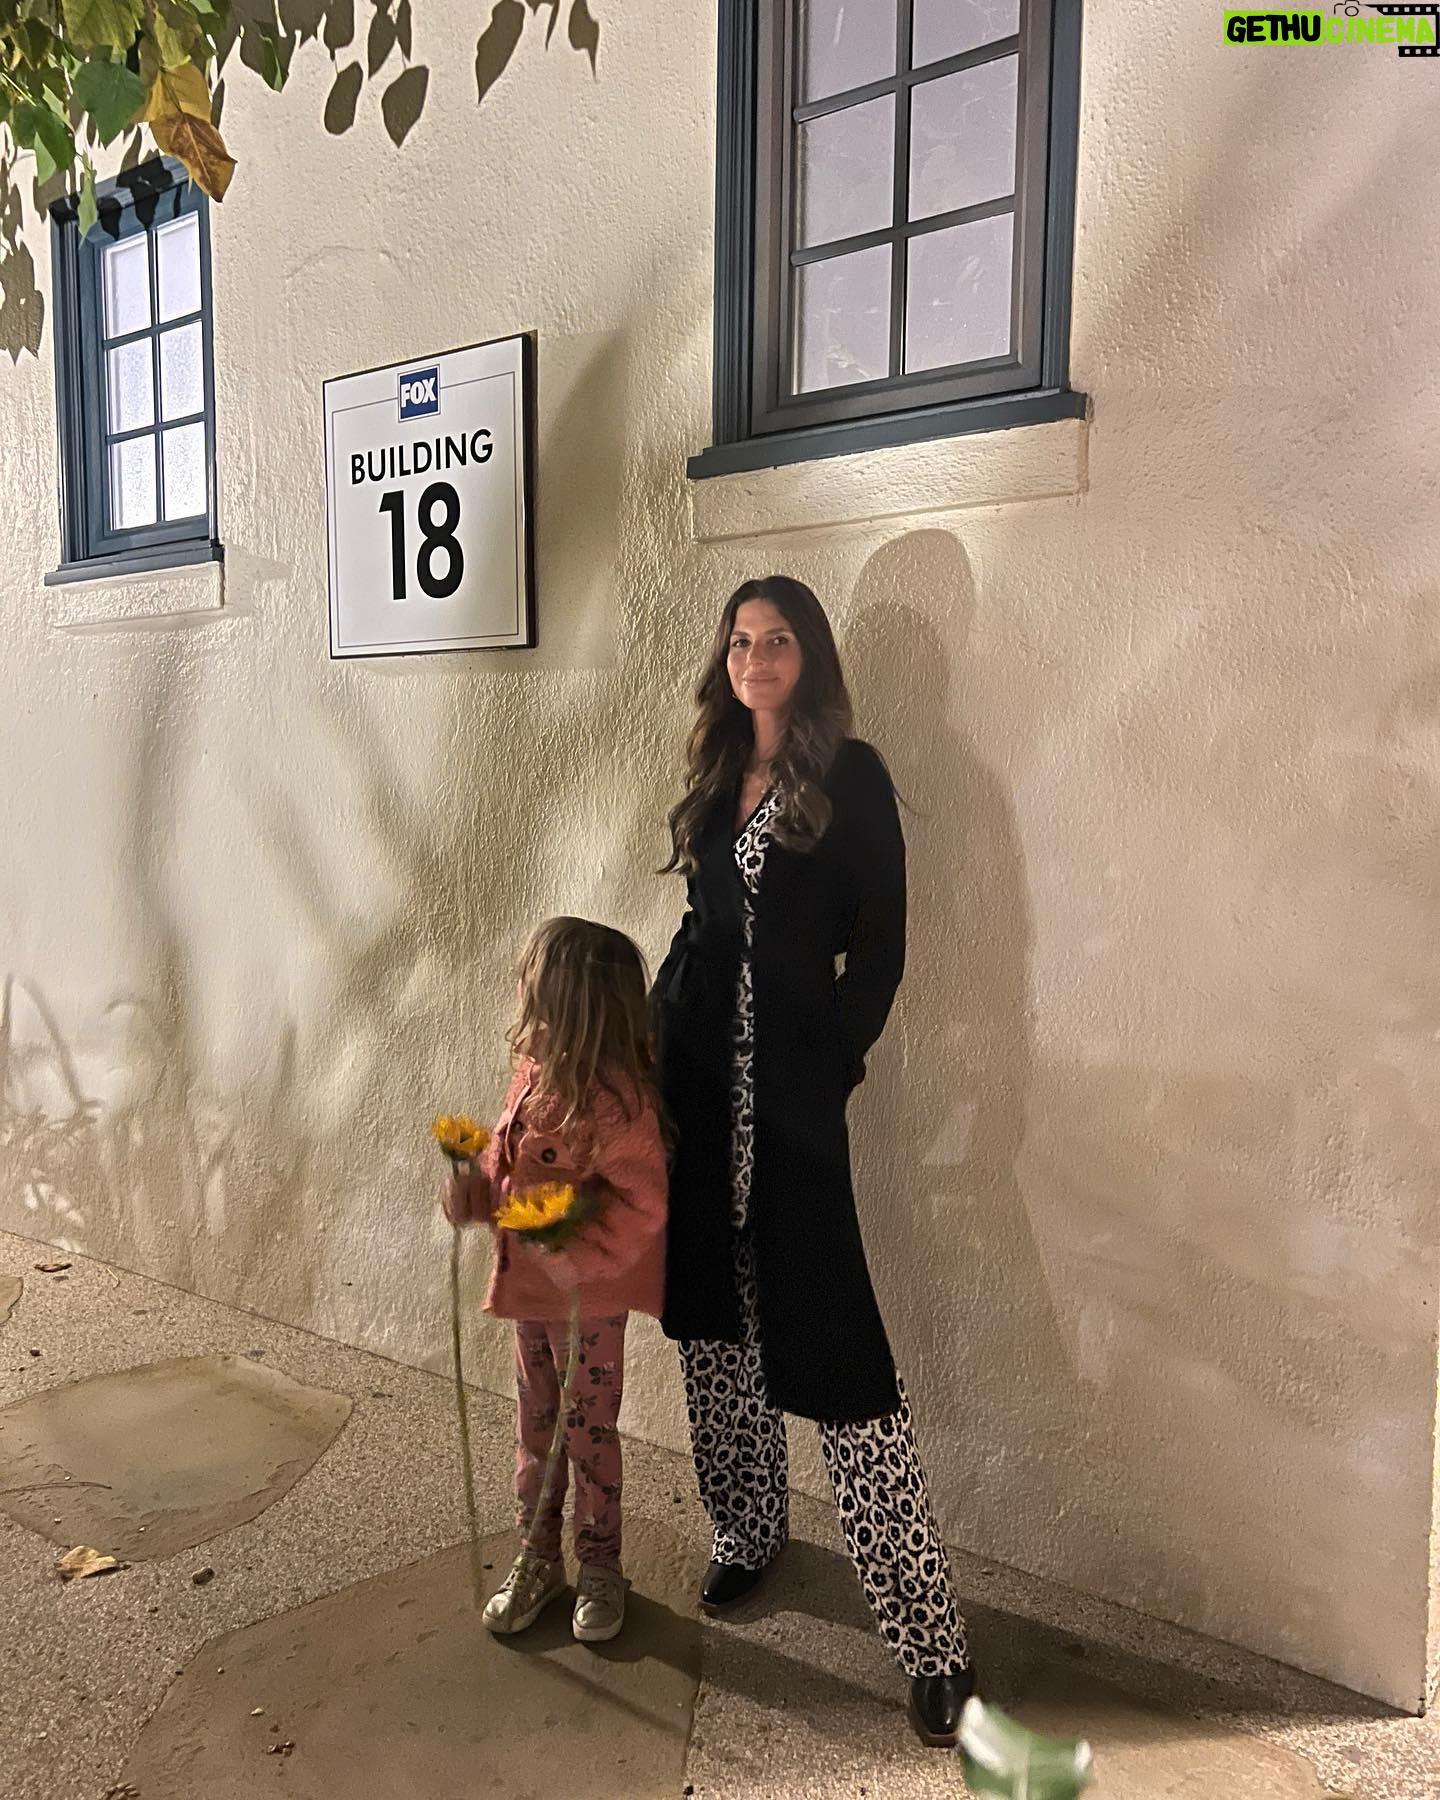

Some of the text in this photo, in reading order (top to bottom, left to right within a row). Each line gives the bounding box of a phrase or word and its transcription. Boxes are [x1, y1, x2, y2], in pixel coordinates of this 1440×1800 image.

[400, 377, 437, 408] FOX
[351, 428, 494, 485] BUILDING
[378, 481, 464, 601] 18
